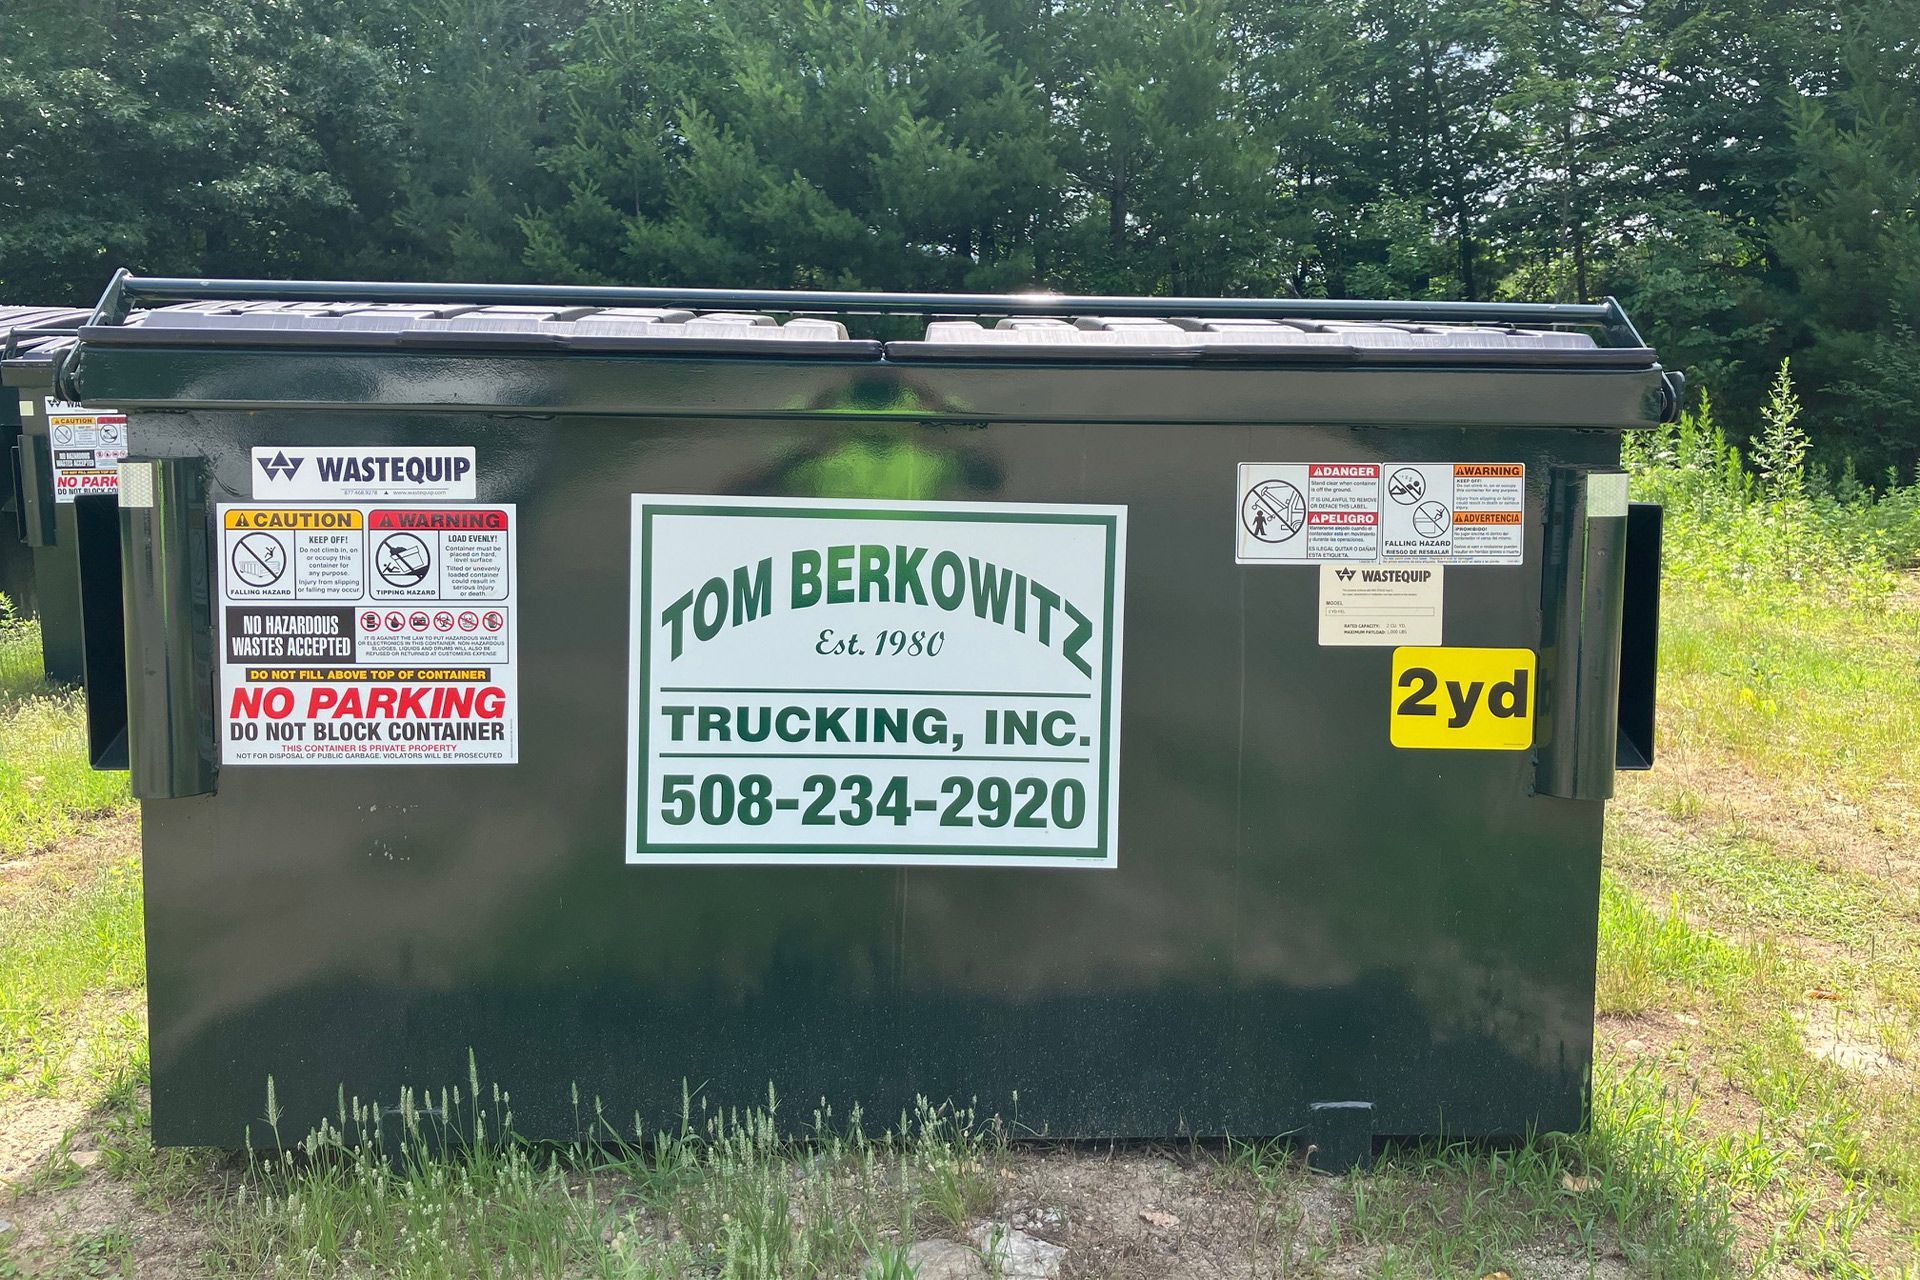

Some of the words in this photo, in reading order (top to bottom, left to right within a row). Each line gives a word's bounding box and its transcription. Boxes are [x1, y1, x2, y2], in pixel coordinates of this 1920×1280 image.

[317, 457, 470, 483] WASTEQUIP
[1324, 467, 1374, 476] DANGER
[1464, 467, 1519, 475] WARNING
[57, 477, 78, 487] NO
[254, 513, 351, 527] CAUTION
[398, 514, 500, 528] WARNING
[1321, 515, 1374, 523] PELIGRO
[1464, 514, 1519, 522] ADVERTENCIA
[1362, 570, 1431, 584] WASTEQUIP
[662, 556, 773, 662] TOM
[791, 544, 1093, 680] BERKOWITZ
[244, 616, 261, 634] NO
[266, 616, 338, 634] HAZARDOUS
[232, 637, 284, 656] WASTES
[287, 637, 350, 656] ACCEPTED
[816, 629, 864, 657] Est.
[876, 629, 945, 657] 1980
[251, 671, 268, 679] DO
[272, 671, 296, 679] NOT
[300, 671, 324, 679] FILL
[328, 671, 367, 679] ABOVE
[370, 671, 394, 679] TOP
[398, 671, 414, 679] OF
[417, 671, 485, 679] CONTAINER
[230, 687, 294, 718] NO
[307, 687, 505, 718] PARKING
[1397, 668, 1528, 728] 2yd
[231, 722, 258, 741] DO
[266, 722, 305, 741] NOT
[314, 722, 381, 741] BLOCK
[389, 722, 504, 741] CONTAINER
[662, 706, 963, 752] TRUCKING,
[985, 710, 1090, 746] INC.
[662, 774, 1086, 829] 508-234-2920
